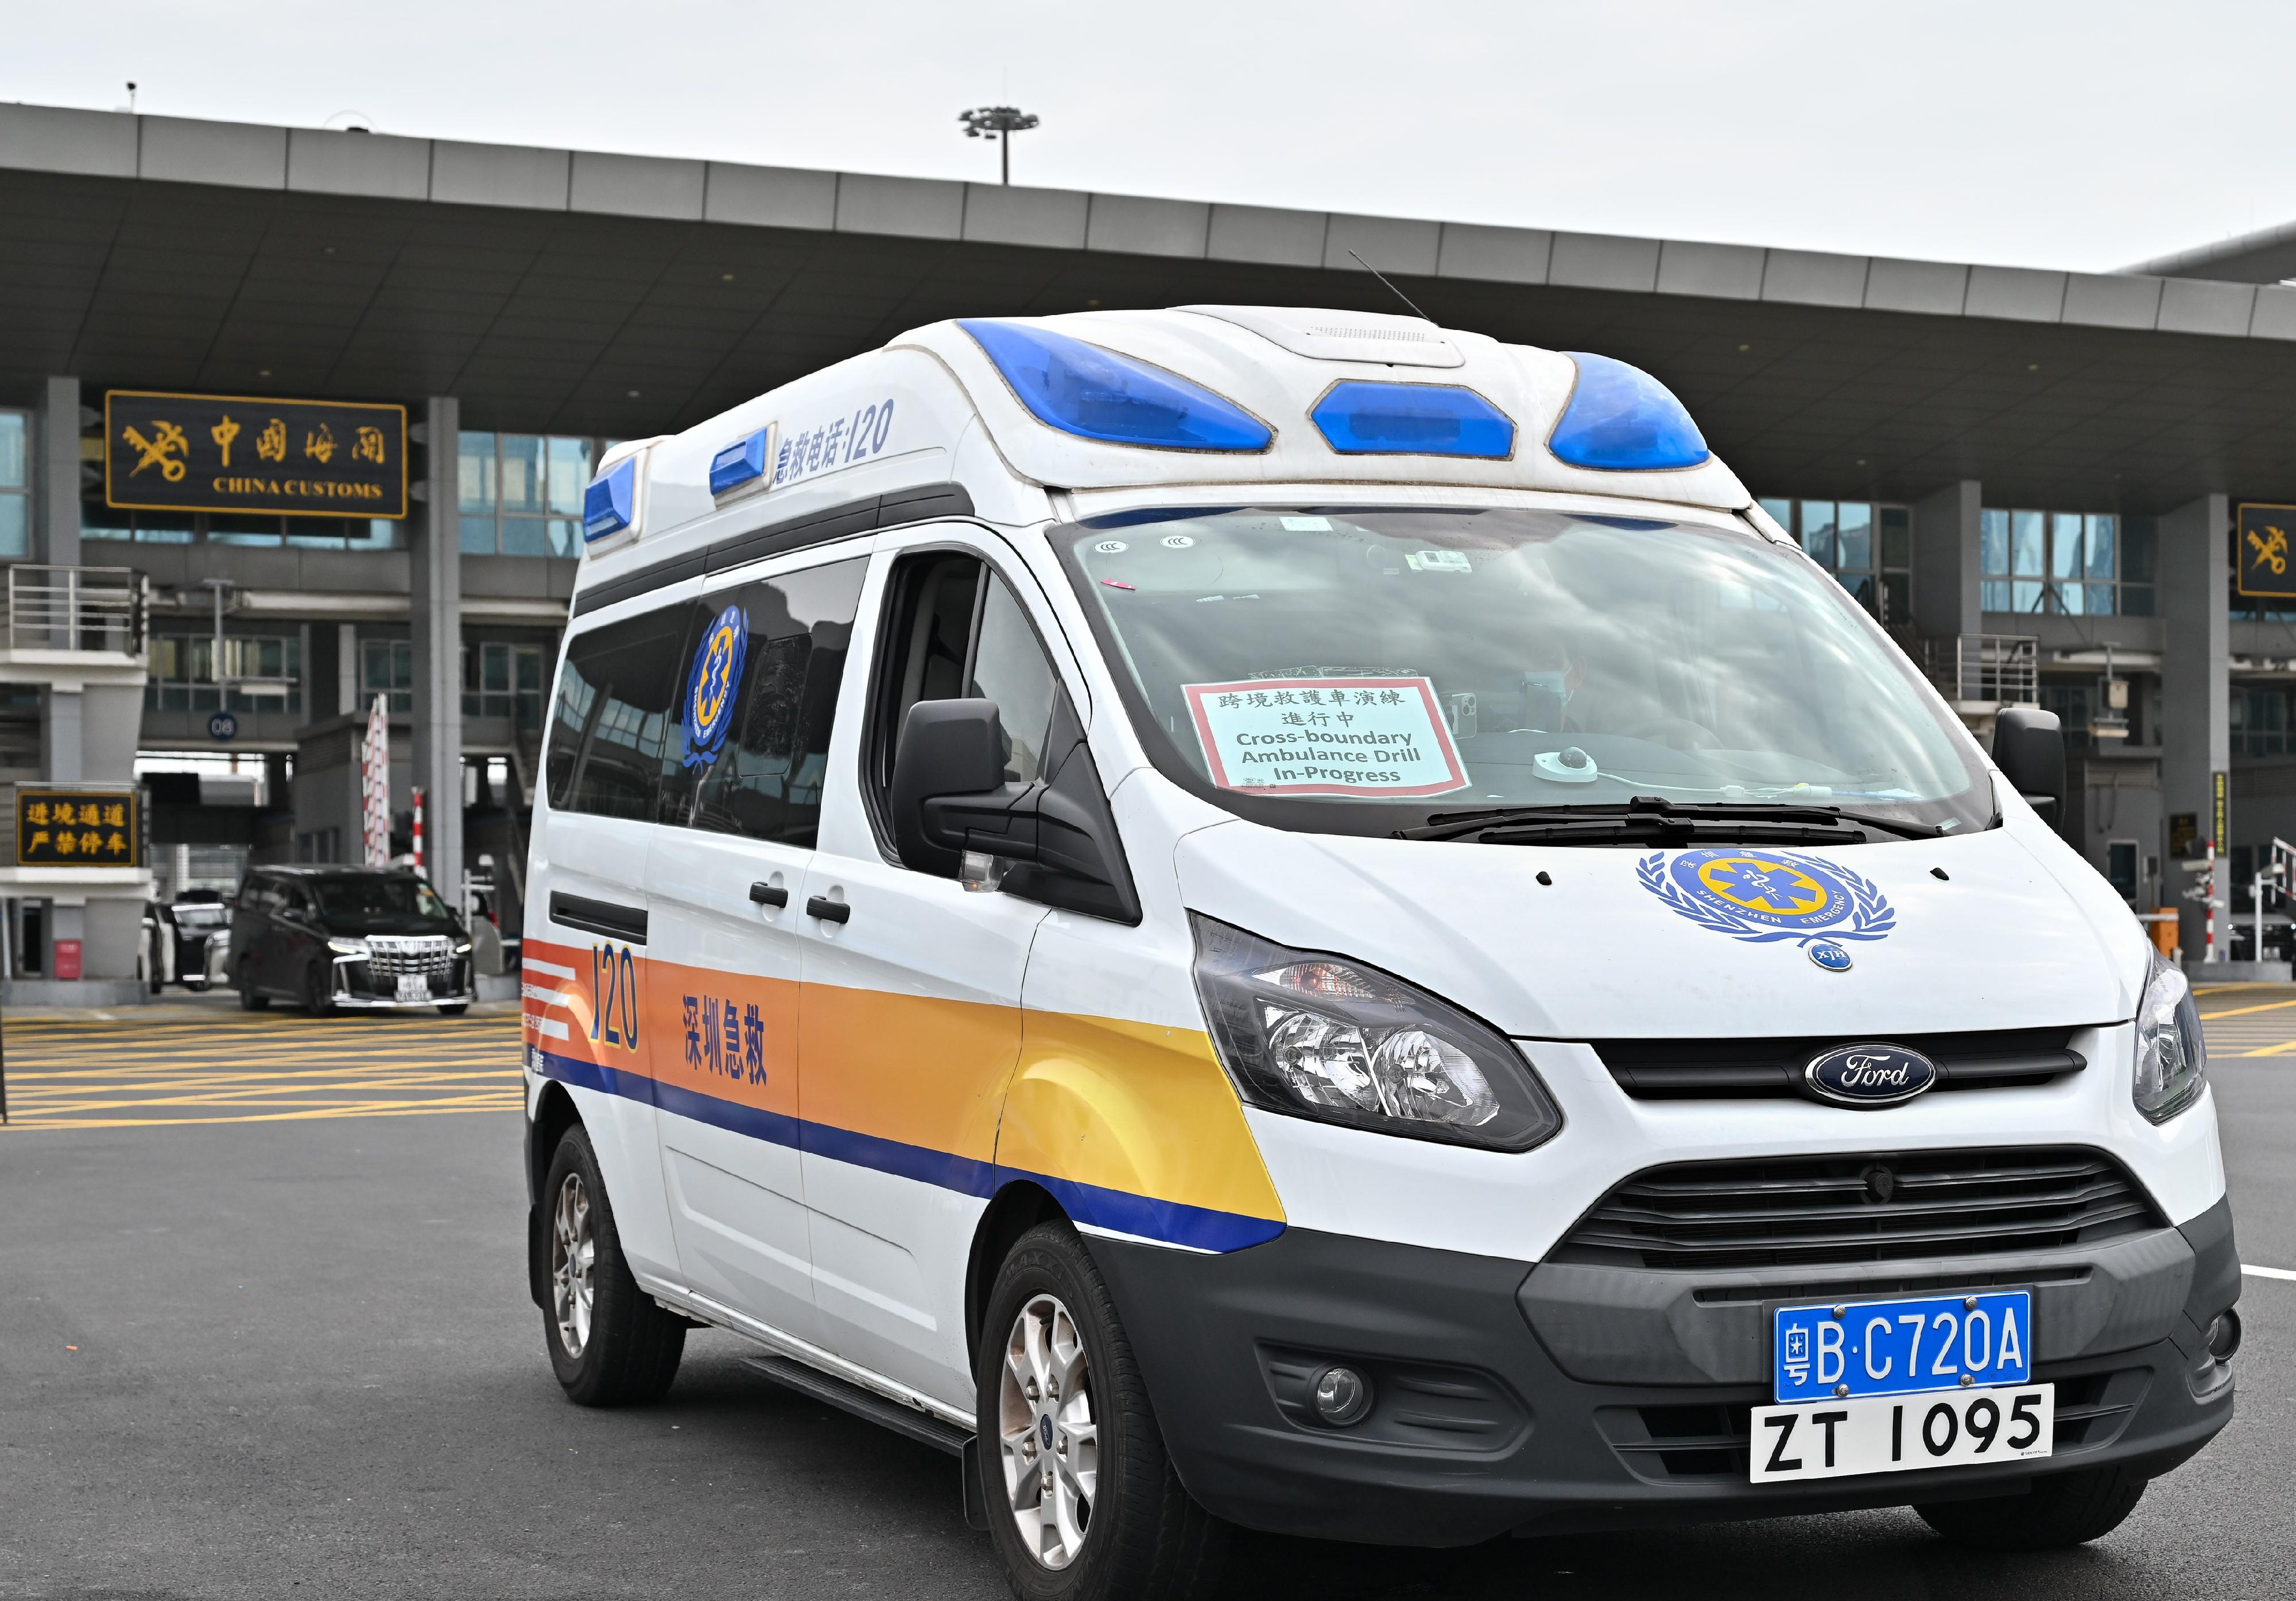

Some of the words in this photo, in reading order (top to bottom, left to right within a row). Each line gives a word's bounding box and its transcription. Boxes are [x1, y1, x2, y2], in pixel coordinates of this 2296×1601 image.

[213, 476, 280, 495] CHINA
[284, 479, 383, 499] CUSTOMS
[1219, 689, 1406, 709] 跨境救護車演練
[1281, 712, 1354, 728] 進行中
[1236, 729, 1412, 746] Cross-boundary
[1242, 748, 1367, 764] Ambulance
[1375, 748, 1421, 762] Drill
[1274, 766, 1401, 783] In-Progress
[1697, 889, 1782, 923] SHENZHEN
[1801, 890, 1845, 924] EMERGENCY
[590, 939, 638, 1054] 120
[682, 994, 767, 1086] 深圳急救
[1841, 1055, 1909, 1087] Ford
[1764, 1411, 1848, 1472] ZT
[1892, 1394, 2041, 1462] 1095
